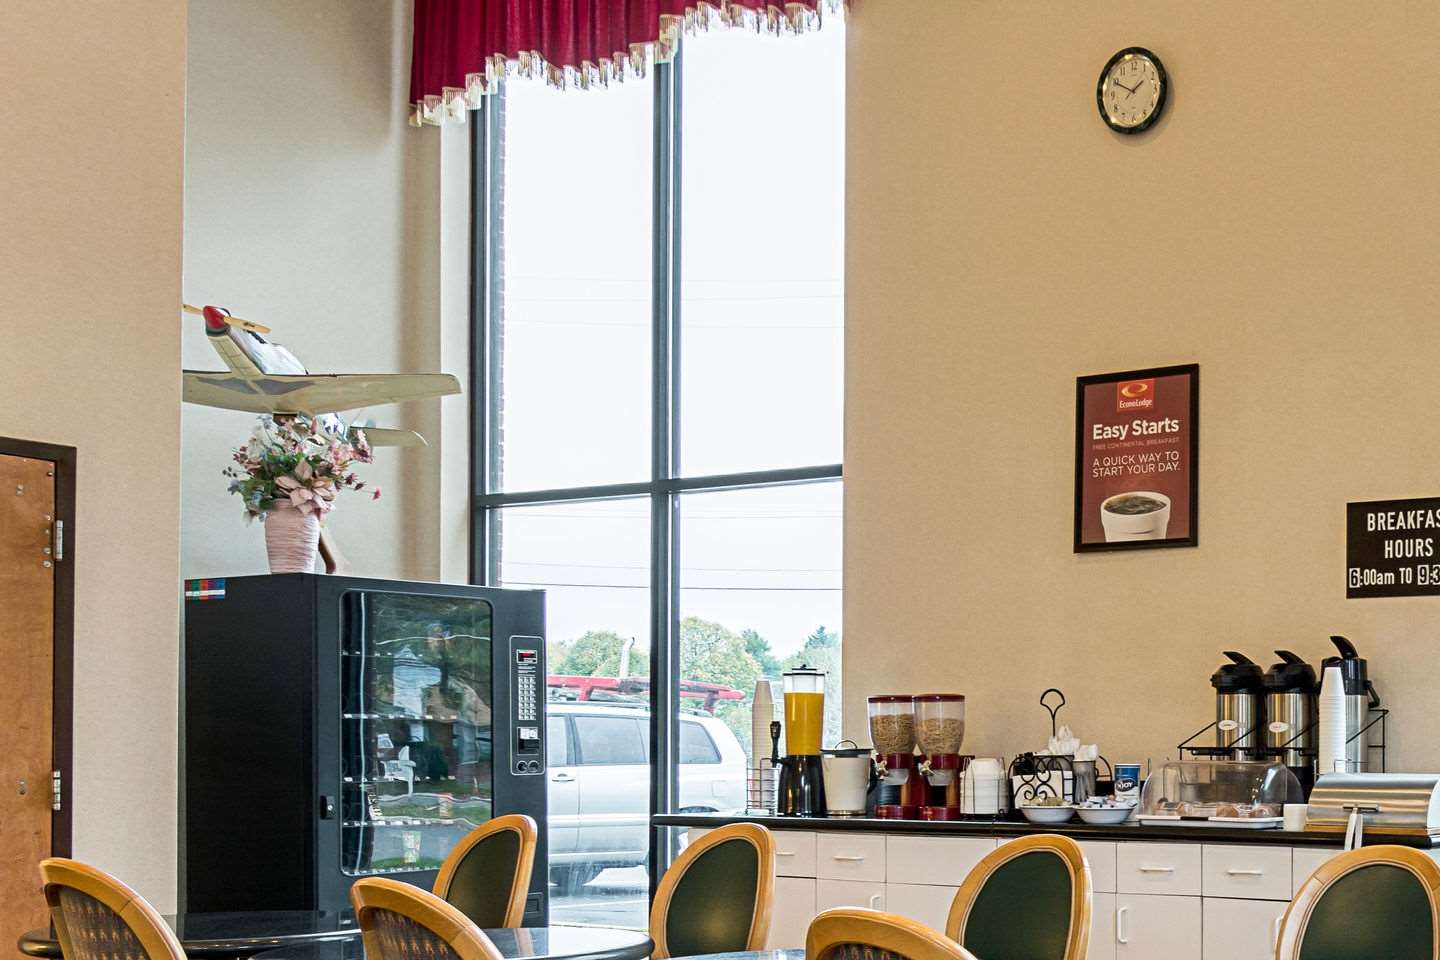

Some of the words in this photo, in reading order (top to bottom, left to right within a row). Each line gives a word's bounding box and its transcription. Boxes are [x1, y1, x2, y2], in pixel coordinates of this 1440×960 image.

[1093, 424, 1129, 440] Easy
[1132, 418, 1179, 435] Starts
[1092, 458, 1100, 468] A
[1102, 455, 1135, 467] QUICK
[1138, 452, 1161, 463] WAY
[1164, 450, 1180, 461] TO
[1092, 465, 1124, 478] START
[1126, 464, 1156, 475] YOUR
[1158, 461, 1181, 472] DAY.
[1384, 538, 1434, 559] HOURS
[1349, 567, 1395, 588] 6:00am
[1399, 567, 1413, 585] TO
